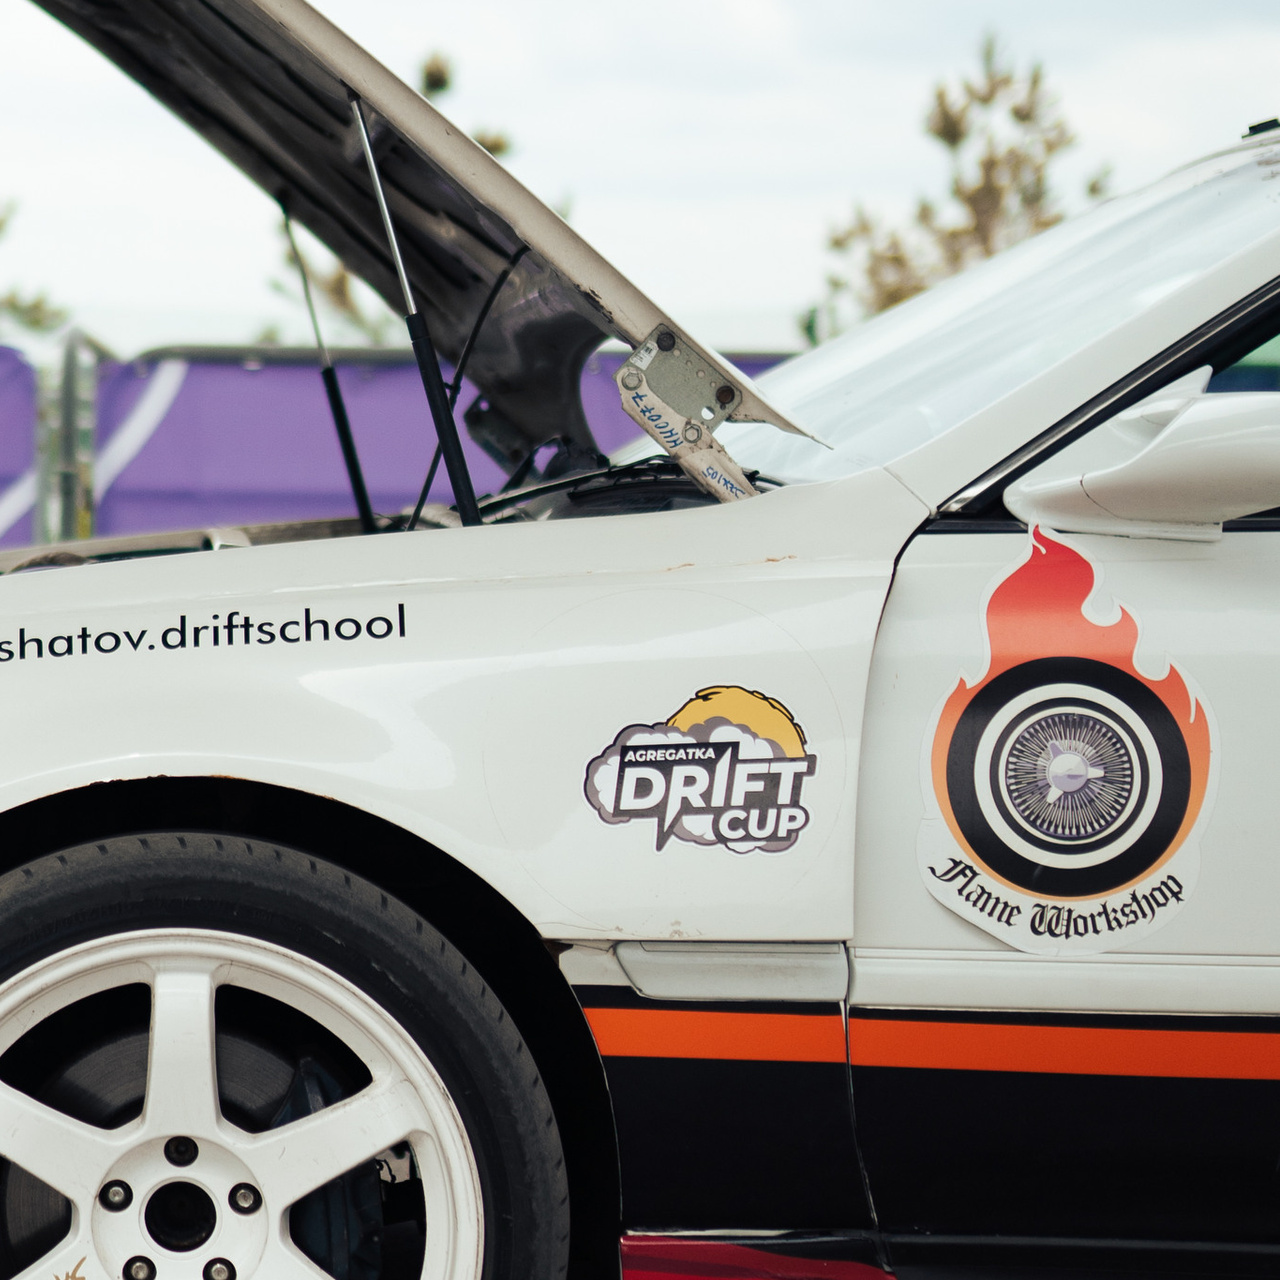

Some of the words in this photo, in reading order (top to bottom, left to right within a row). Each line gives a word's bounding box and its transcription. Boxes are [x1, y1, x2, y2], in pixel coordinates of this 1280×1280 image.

[624, 747, 716, 763] AGREGATKA
[619, 746, 809, 834] DRIFT
[718, 808, 807, 840] CUP
[927, 857, 1023, 927] Flame
[1029, 874, 1185, 940] Workshop
